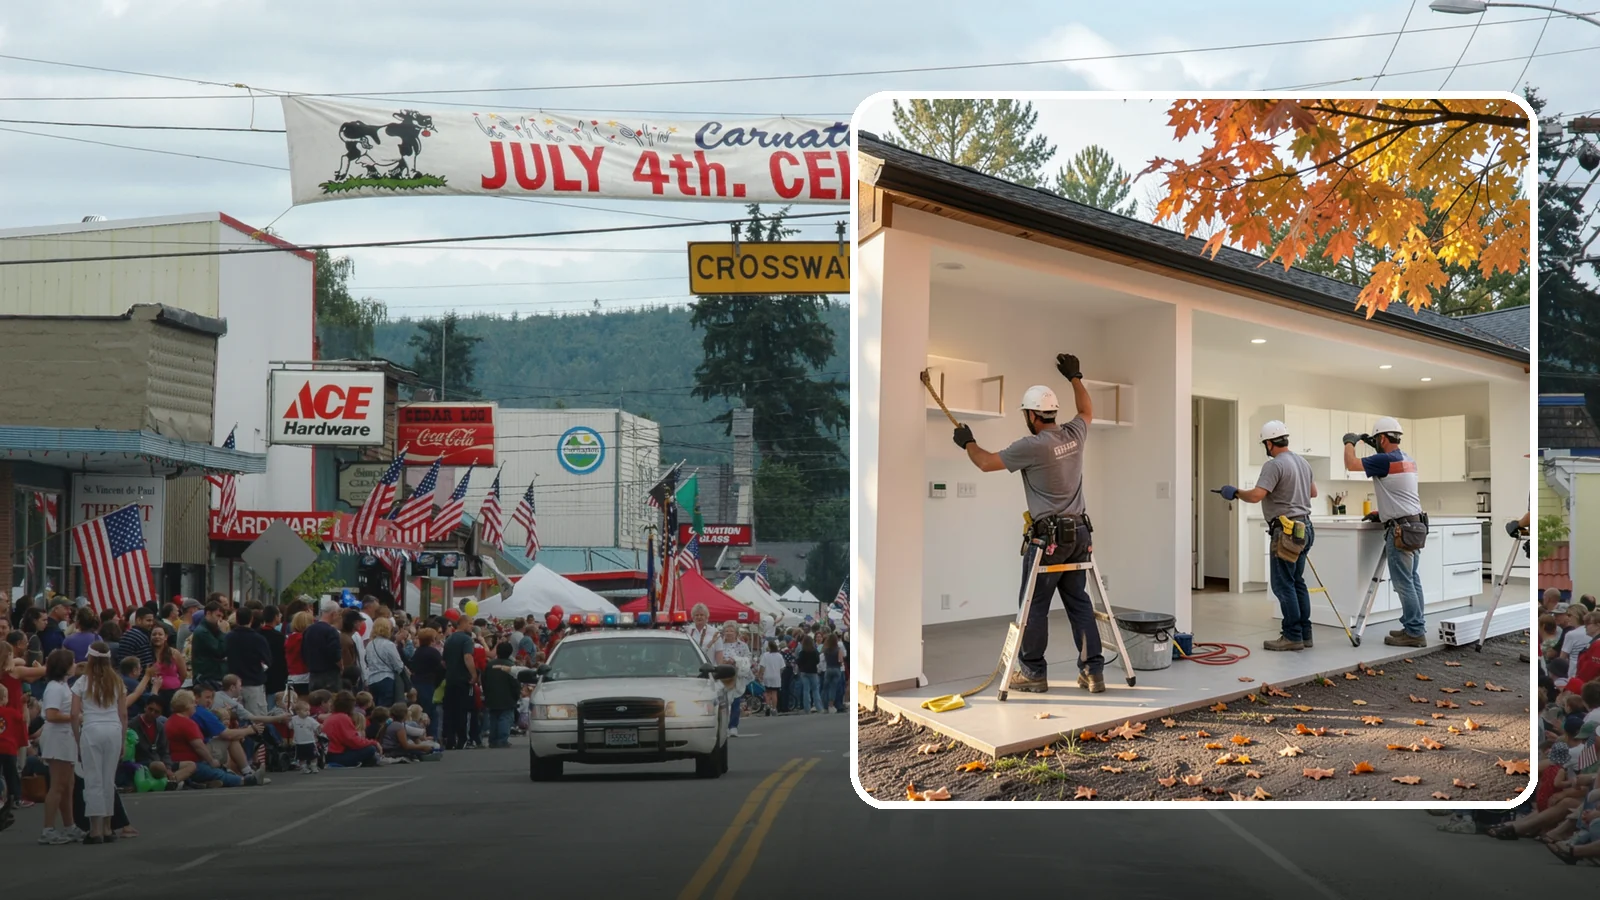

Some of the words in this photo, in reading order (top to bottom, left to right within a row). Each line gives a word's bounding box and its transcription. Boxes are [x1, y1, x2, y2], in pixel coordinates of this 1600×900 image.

[481, 141, 605, 193] JULY
[632, 150, 746, 197] 4th.
[697, 254, 850, 280] CROSSWA
[282, 380, 373, 420] ACE
[405, 409, 453, 422] CEDAR
[283, 421, 371, 436] Hardware
[416, 428, 477, 447] Coca-Cola
[353, 467, 386, 479] Simpl
[83, 484, 94, 494] St.
[95, 485, 125, 495] Vincent
[126, 486, 136, 495] de
[137, 486, 155, 495] Paul
[81, 503, 154, 522] THT
[213, 516, 330, 535] HARDARE
[688, 526, 741, 535] CRNATION
[699, 535, 730, 543] GLASS
